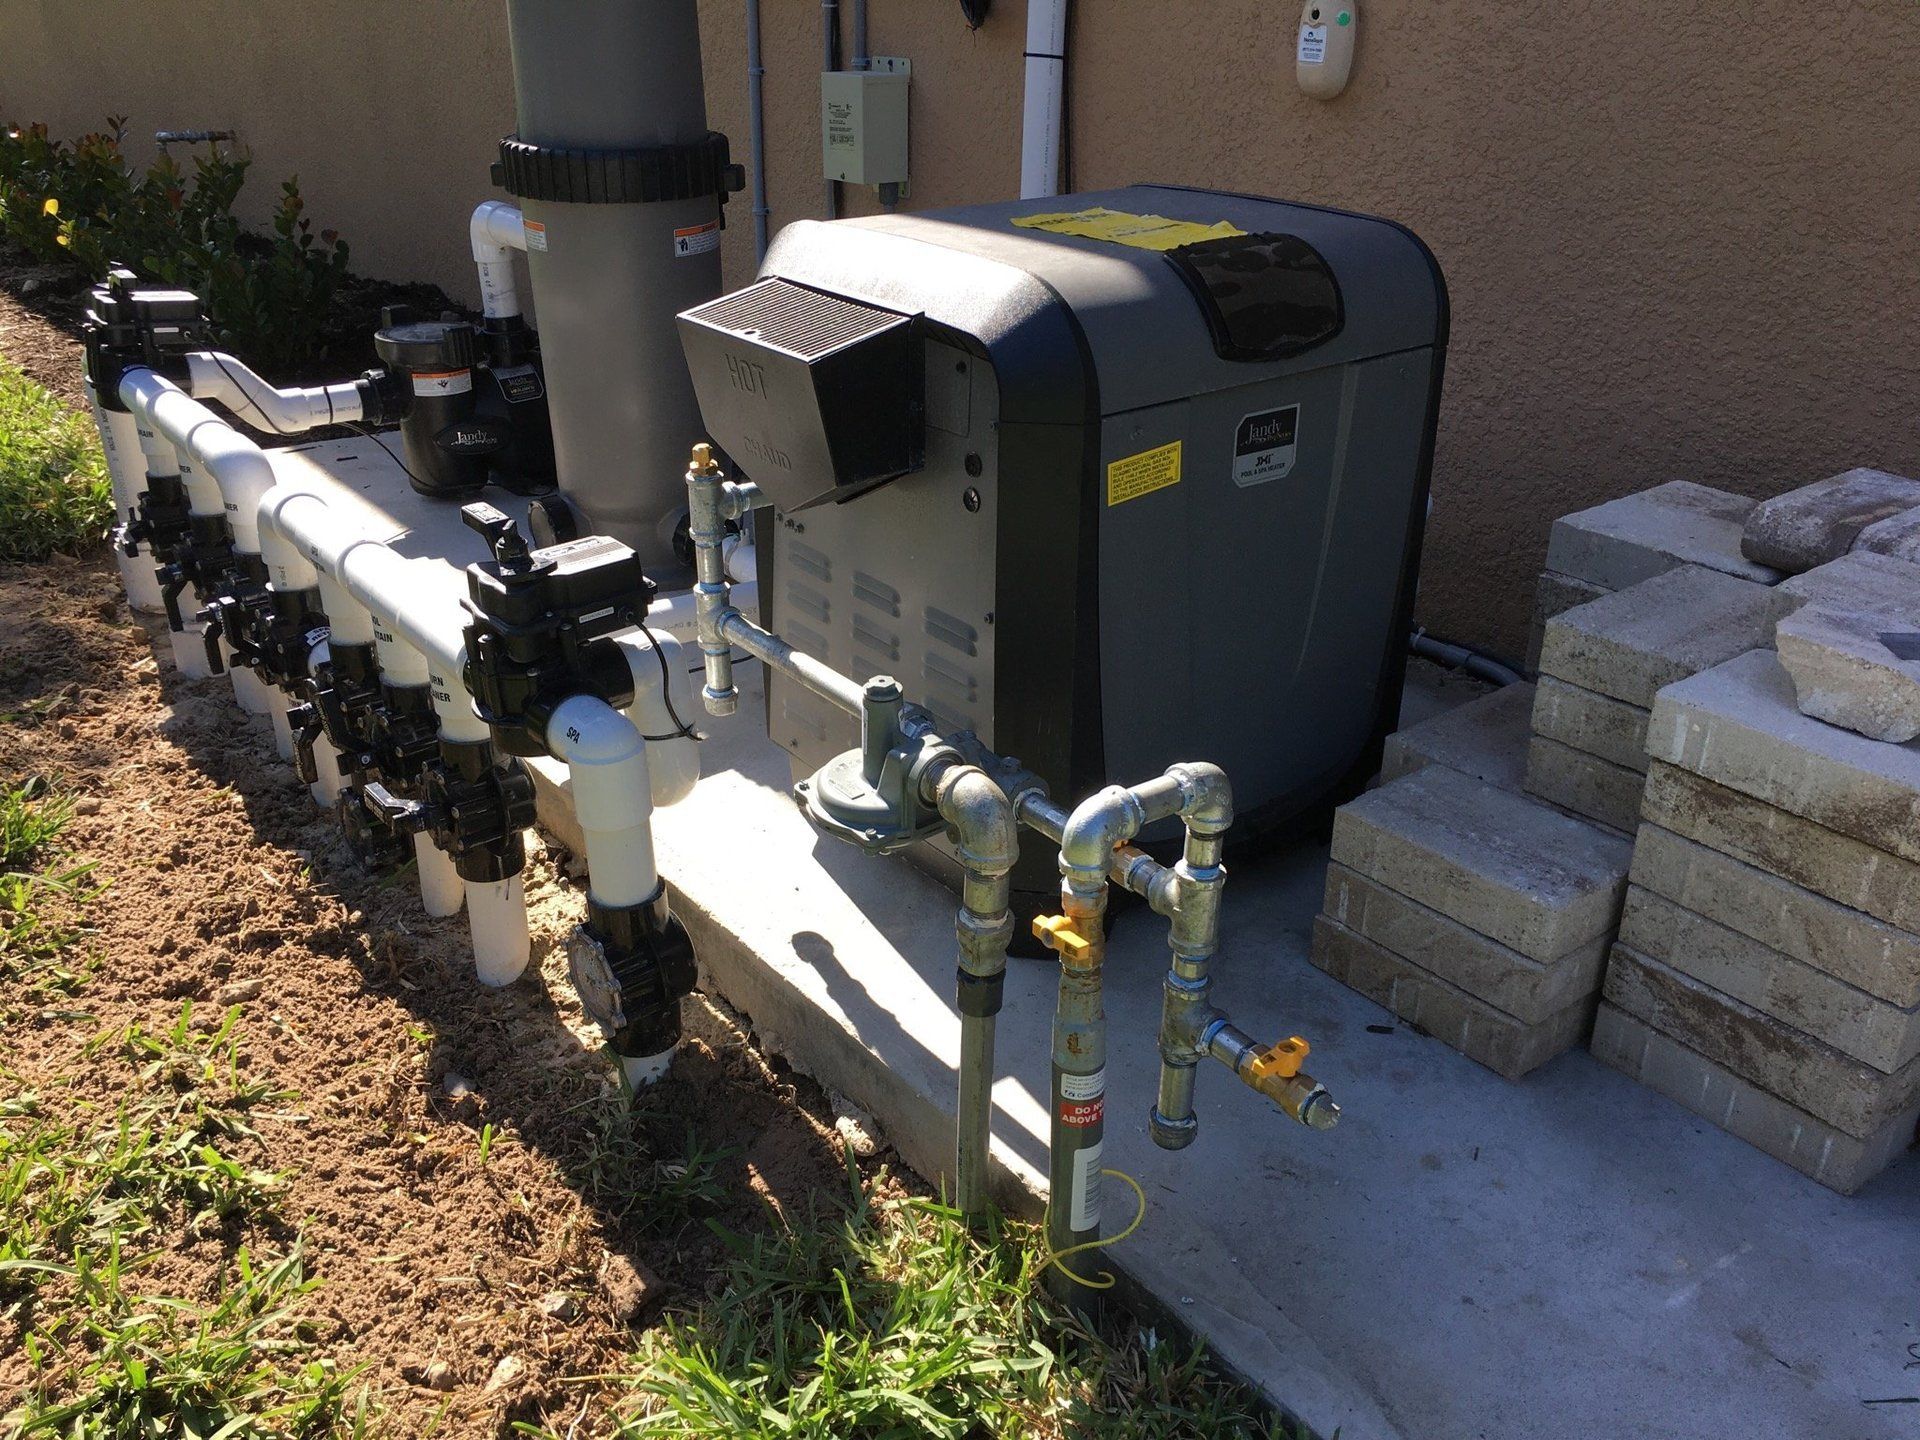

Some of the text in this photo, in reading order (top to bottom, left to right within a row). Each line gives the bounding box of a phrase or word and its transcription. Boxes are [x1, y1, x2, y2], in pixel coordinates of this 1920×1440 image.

[724, 353, 767, 399] HOT
[456, 430, 487, 444] Jandy
[1246, 419, 1282, 444] Jandy
[744, 435, 791, 471] CHAUD
[1124, 459, 1144, 468] PRODUCT
[1145, 451, 1165, 462] COMPLIES
[1133, 463, 1151, 471] NATURAL
[1152, 460, 1174, 470] INSTALLED
[1124, 475, 1145, 485] OPERATED
[1146, 466, 1170, 477] ACCORDING
[1241, 471, 1253, 479] POOL
[1113, 488, 1142, 501] INSTALLATION
[566, 726, 580, 744] SPA
[1075, 1106, 1091, 1115] DO
[1062, 1113, 1098, 1124] ABOVE
